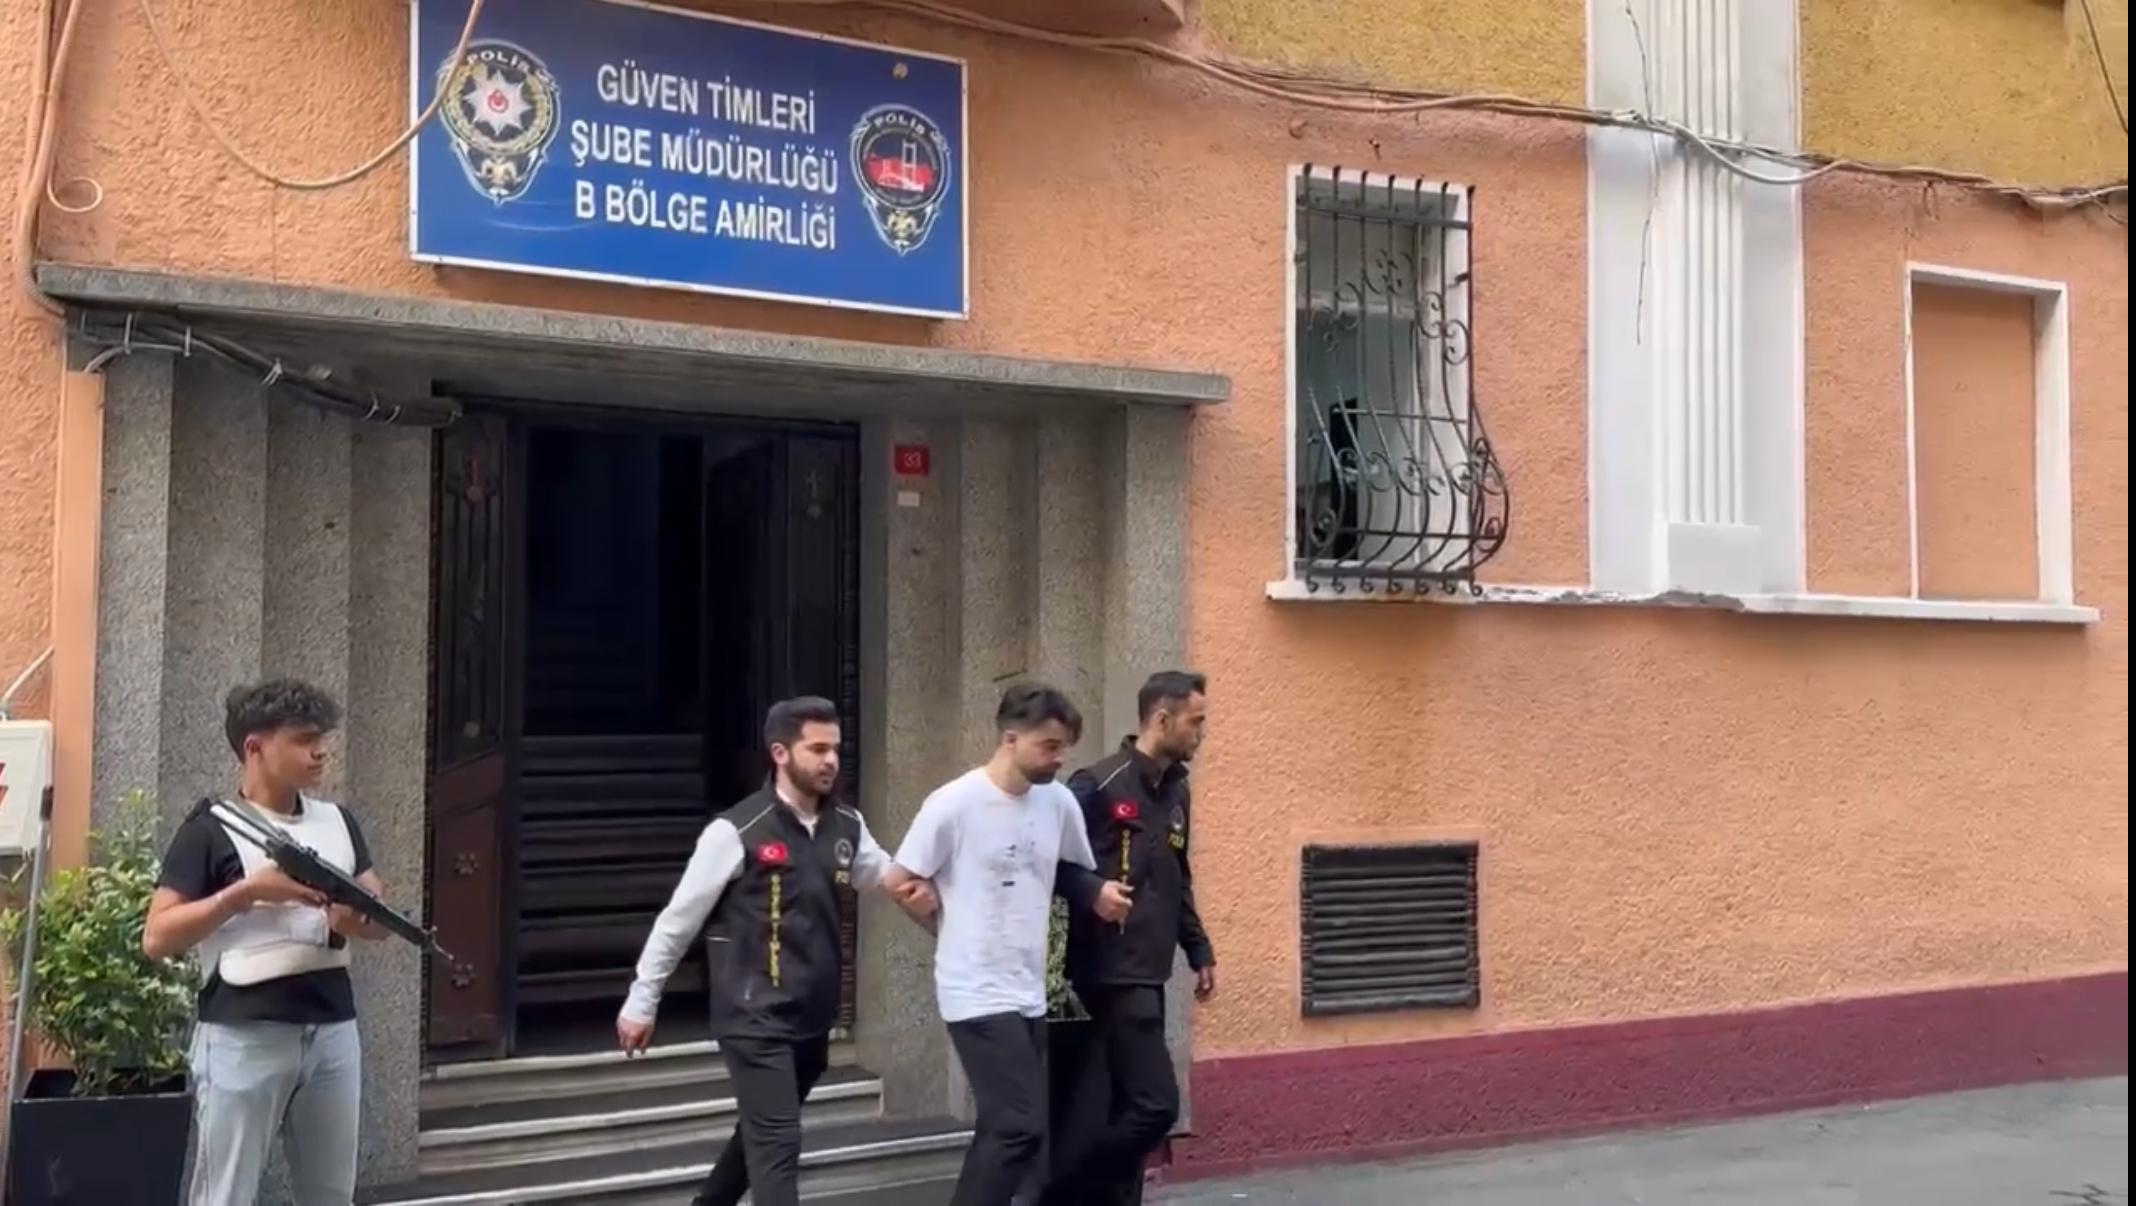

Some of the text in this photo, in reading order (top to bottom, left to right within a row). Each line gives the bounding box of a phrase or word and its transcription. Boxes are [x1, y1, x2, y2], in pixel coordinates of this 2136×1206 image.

[596, 58, 816, 135] GÜVEN TİMLERİ
[570, 118, 839, 195] ŞUBE MÜDÜRLÜĞÜ
[576, 178, 836, 251] B BÖLGE AMİRLİĞİ
